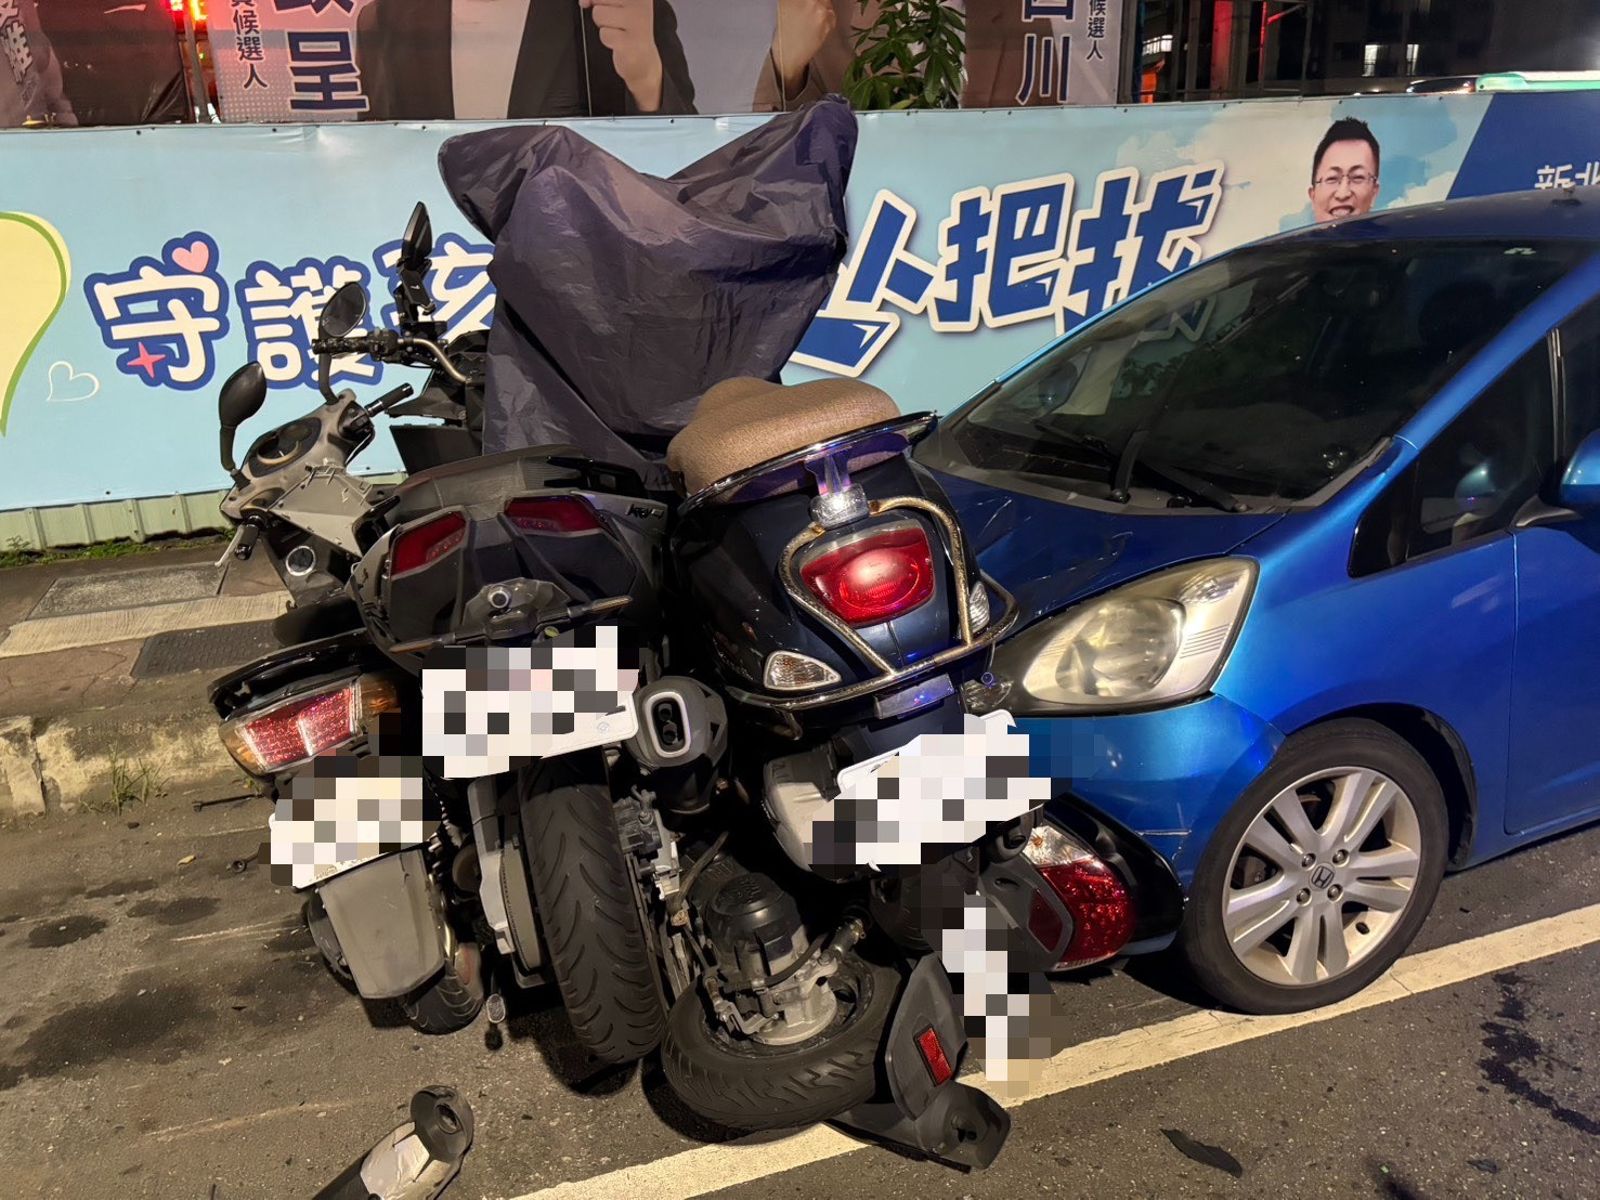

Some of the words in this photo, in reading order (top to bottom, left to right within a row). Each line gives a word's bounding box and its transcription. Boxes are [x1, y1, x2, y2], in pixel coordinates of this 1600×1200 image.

[231, 0, 268, 90] 候選人
[273, 0, 369, 111] 呈
